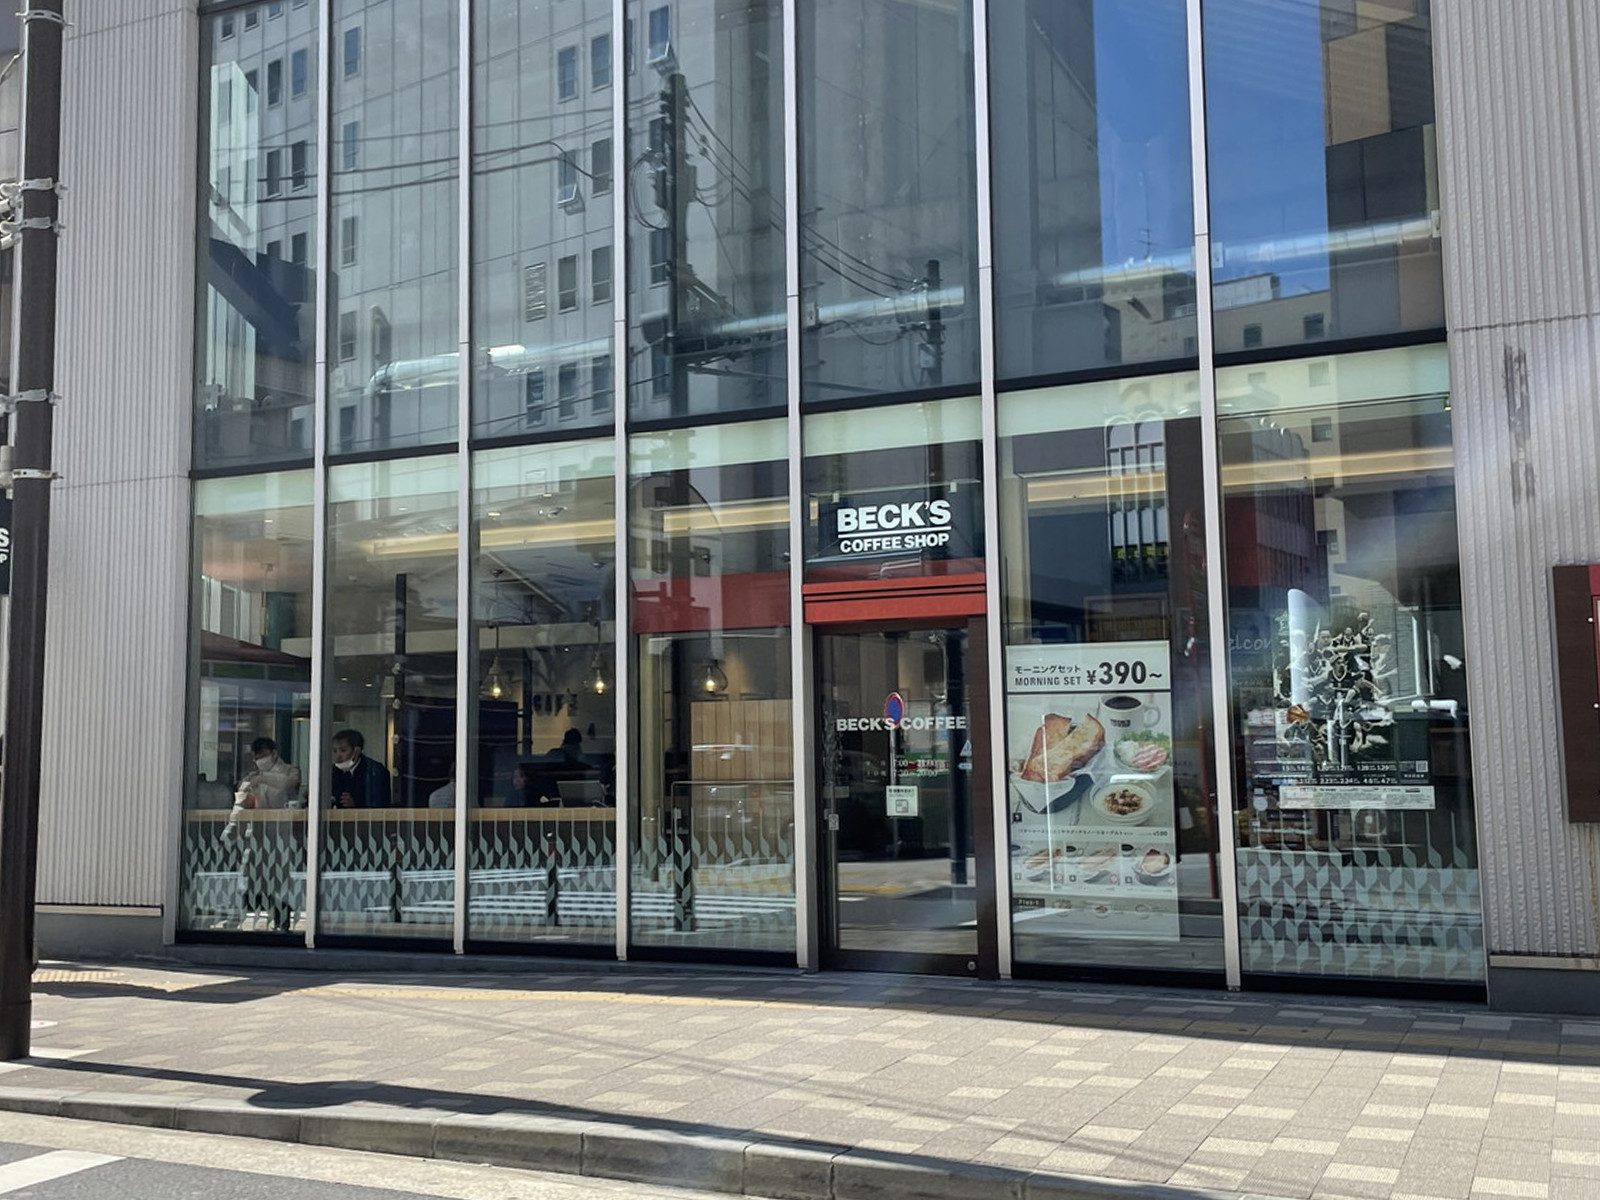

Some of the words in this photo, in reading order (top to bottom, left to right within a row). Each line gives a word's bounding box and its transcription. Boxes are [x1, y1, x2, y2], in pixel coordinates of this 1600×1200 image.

[837, 500, 951, 532] BECK'S
[840, 536, 902, 553] COFFEE
[904, 533, 949, 548] SHOP
[1015, 665, 1081, 675] モーニングセット
[1015, 677, 1060, 687] MORNING
[1064, 675, 1081, 685] SET
[836, 718, 895, 731] BECK'S
[899, 716, 967, 730] COFFEE
